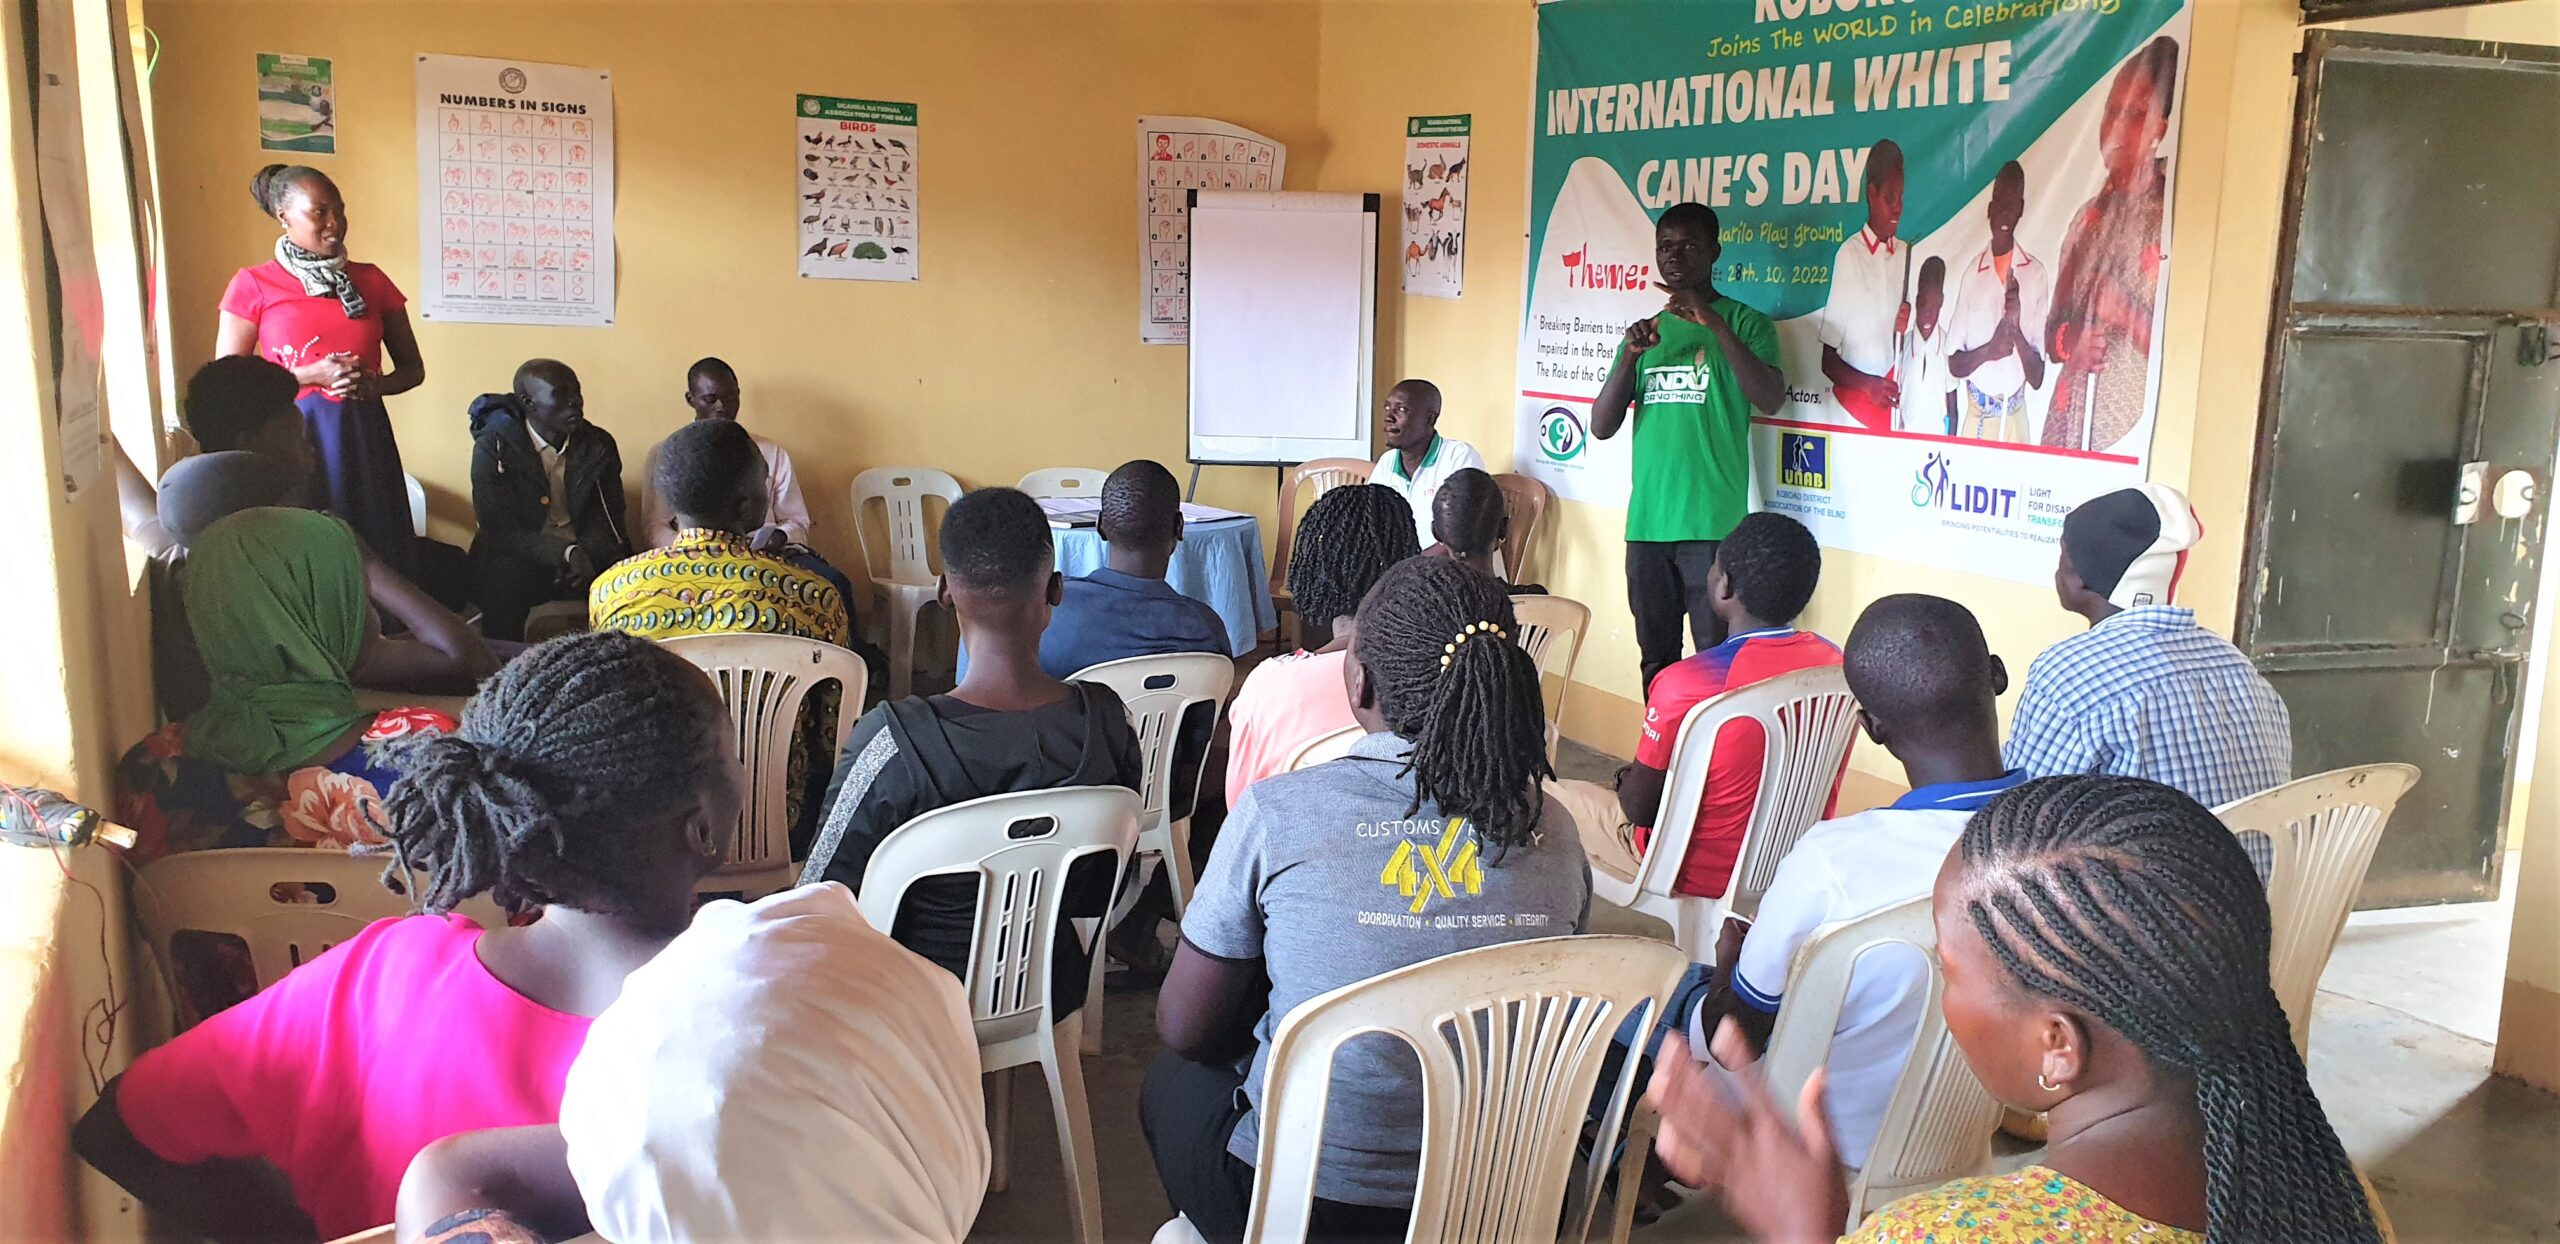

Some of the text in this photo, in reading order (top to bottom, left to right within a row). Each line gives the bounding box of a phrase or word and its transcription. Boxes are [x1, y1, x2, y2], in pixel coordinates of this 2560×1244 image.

[1707, 34, 1760, 57] Joins
[1771, 28, 1803, 49] The
[1813, 15, 1897, 44] WORLD
[1911, 10, 1932, 35] in
[1547, 40, 2012, 136] INTERNATIONAL WHITE
[440, 93, 586, 115] NUMBERS IN SIGNS
[840, 121, 877, 133] BIRDS
[1636, 147, 1873, 208] CANE'S DAY
[1759, 222, 1789, 249] Play
[1793, 221, 1844, 248] ground
[1562, 240, 1649, 291] Theme:
[1727, 262, 1760, 283] 28th.
[1764, 266, 1787, 283] 10.
[1791, 265, 1829, 284] 2022
[1573, 316, 1604, 334] Barriers
[1606, 322, 1614, 334] to
[1615, 320, 1626, 336] incl
[1537, 338, 1614, 358] Impaired in the Post
[1536, 361, 1550, 377] The
[1552, 362, 1568, 379] Role
[1570, 364, 1580, 380] of
[1581, 365, 1594, 381] the
[1785, 384, 1822, 405] Actors.
[1784, 468, 1824, 488] UNAB
[1803, 494, 1831, 504] DISTRICT
[1951, 483, 2017, 518] LIDIT
[2029, 487, 2052, 499] LIGHT
[1764, 499, 1846, 519] ASSOCIATION OF THE BLIND
[2028, 501, 2045, 512] FOR
[2027, 514, 2065, 528] TRANSFO
[1941, 520, 2060, 545] BRINGING POTENTIALITIES TO REALIZAT
[1356, 820, 1440, 837] CUSTOMS
[1358, 911, 1549, 928] COORDINATION QUALITY SERVICE INTEGRITY
